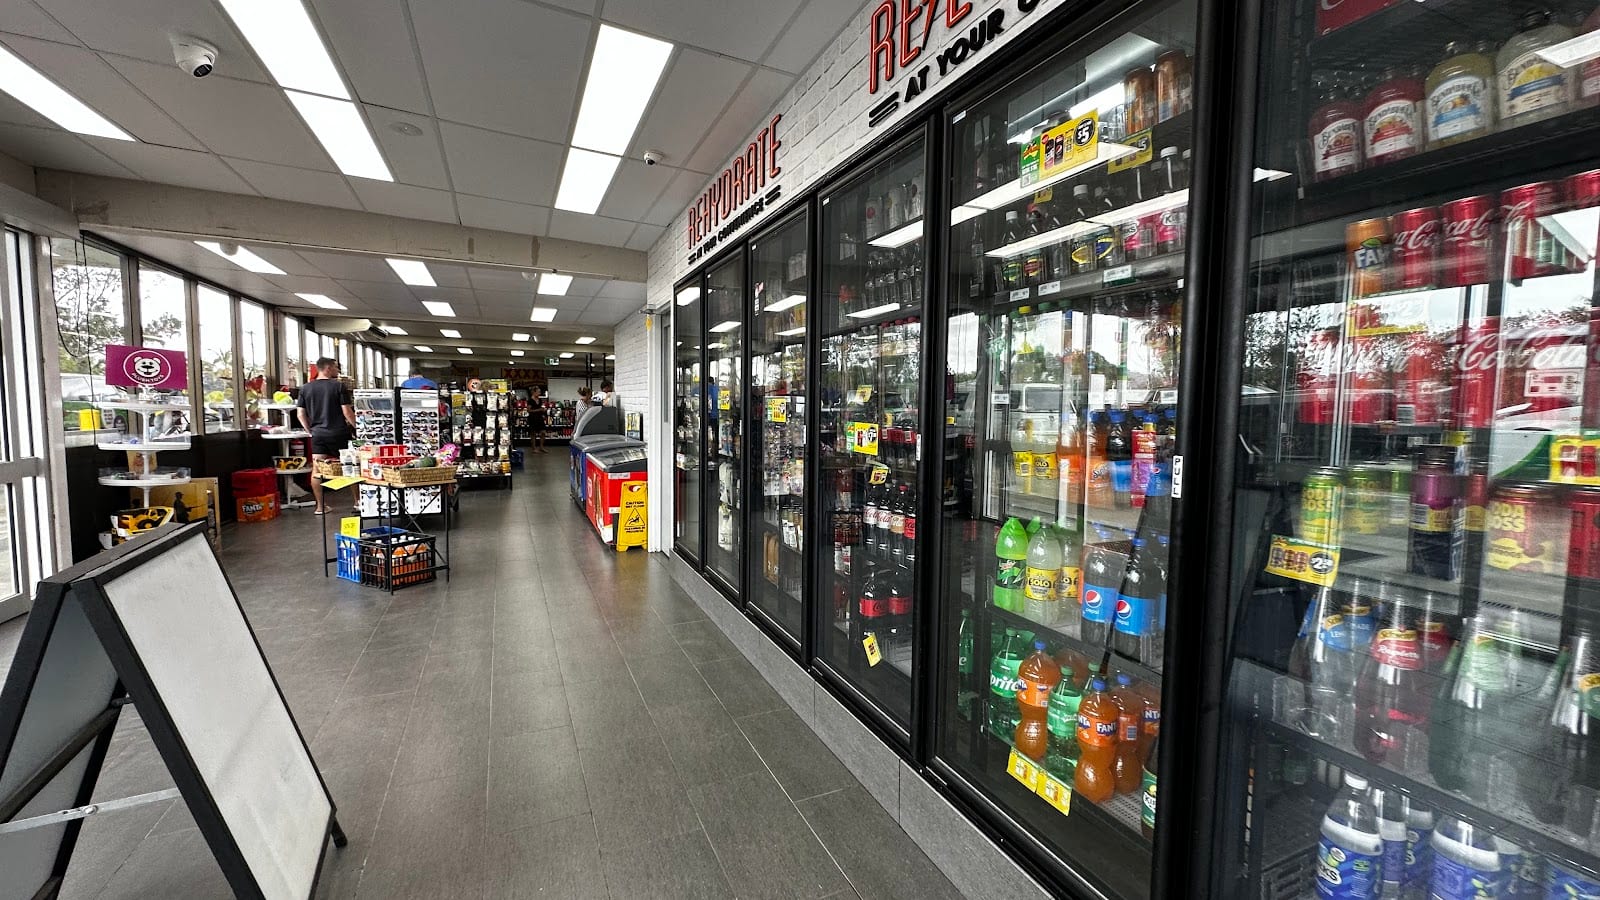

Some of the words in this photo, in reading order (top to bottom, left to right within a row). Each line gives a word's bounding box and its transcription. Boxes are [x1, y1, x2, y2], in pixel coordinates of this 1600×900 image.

[904, 65, 930, 102] AT
[936, 8, 1005, 76] YOUR
[688, 114, 781, 250] REHYDRATE
[1172, 458, 1181, 496] PULL
[1029, 578, 1051, 588] SOLO
[990, 670, 1020, 692] prite
